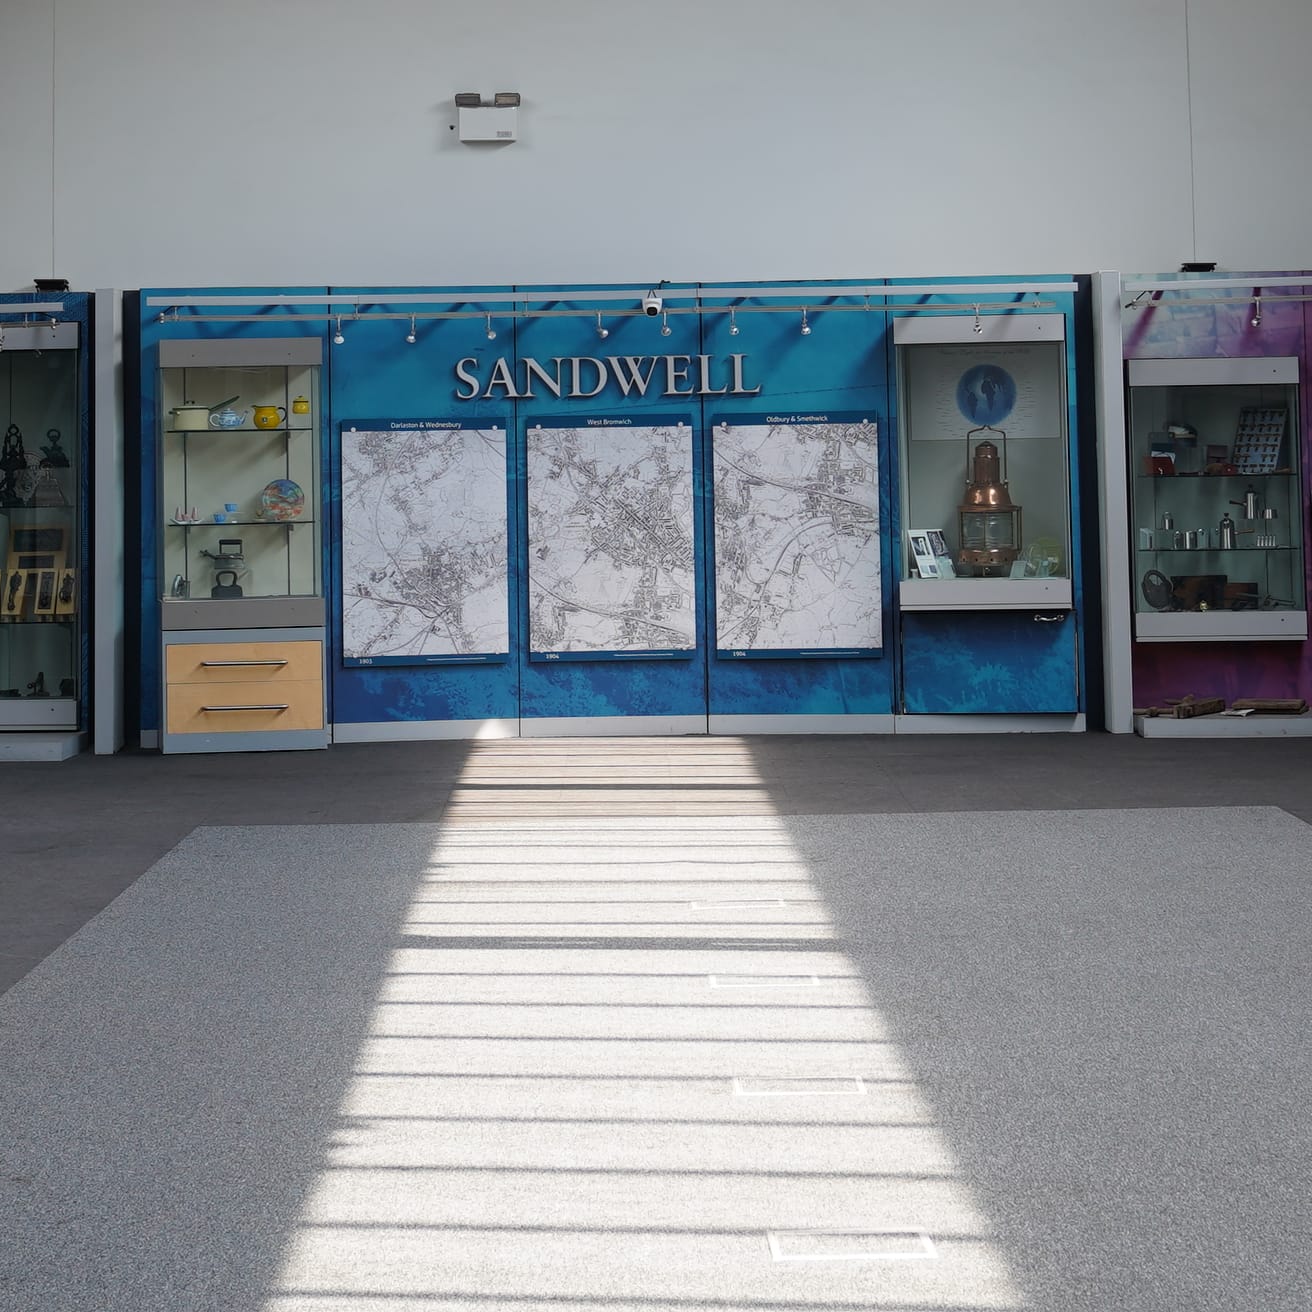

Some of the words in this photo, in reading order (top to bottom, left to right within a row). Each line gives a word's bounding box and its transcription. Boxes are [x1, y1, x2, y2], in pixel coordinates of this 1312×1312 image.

[455, 353, 763, 400] SANDWELL
[586, 418, 602, 426] West
[603, 418, 633, 426] Bromwich
[766, 415, 790, 424] Oldbury
[796, 414, 828, 423] Smethwick
[390, 422, 419, 430] Darlaston
[425, 420, 462, 430] Wednesbury
